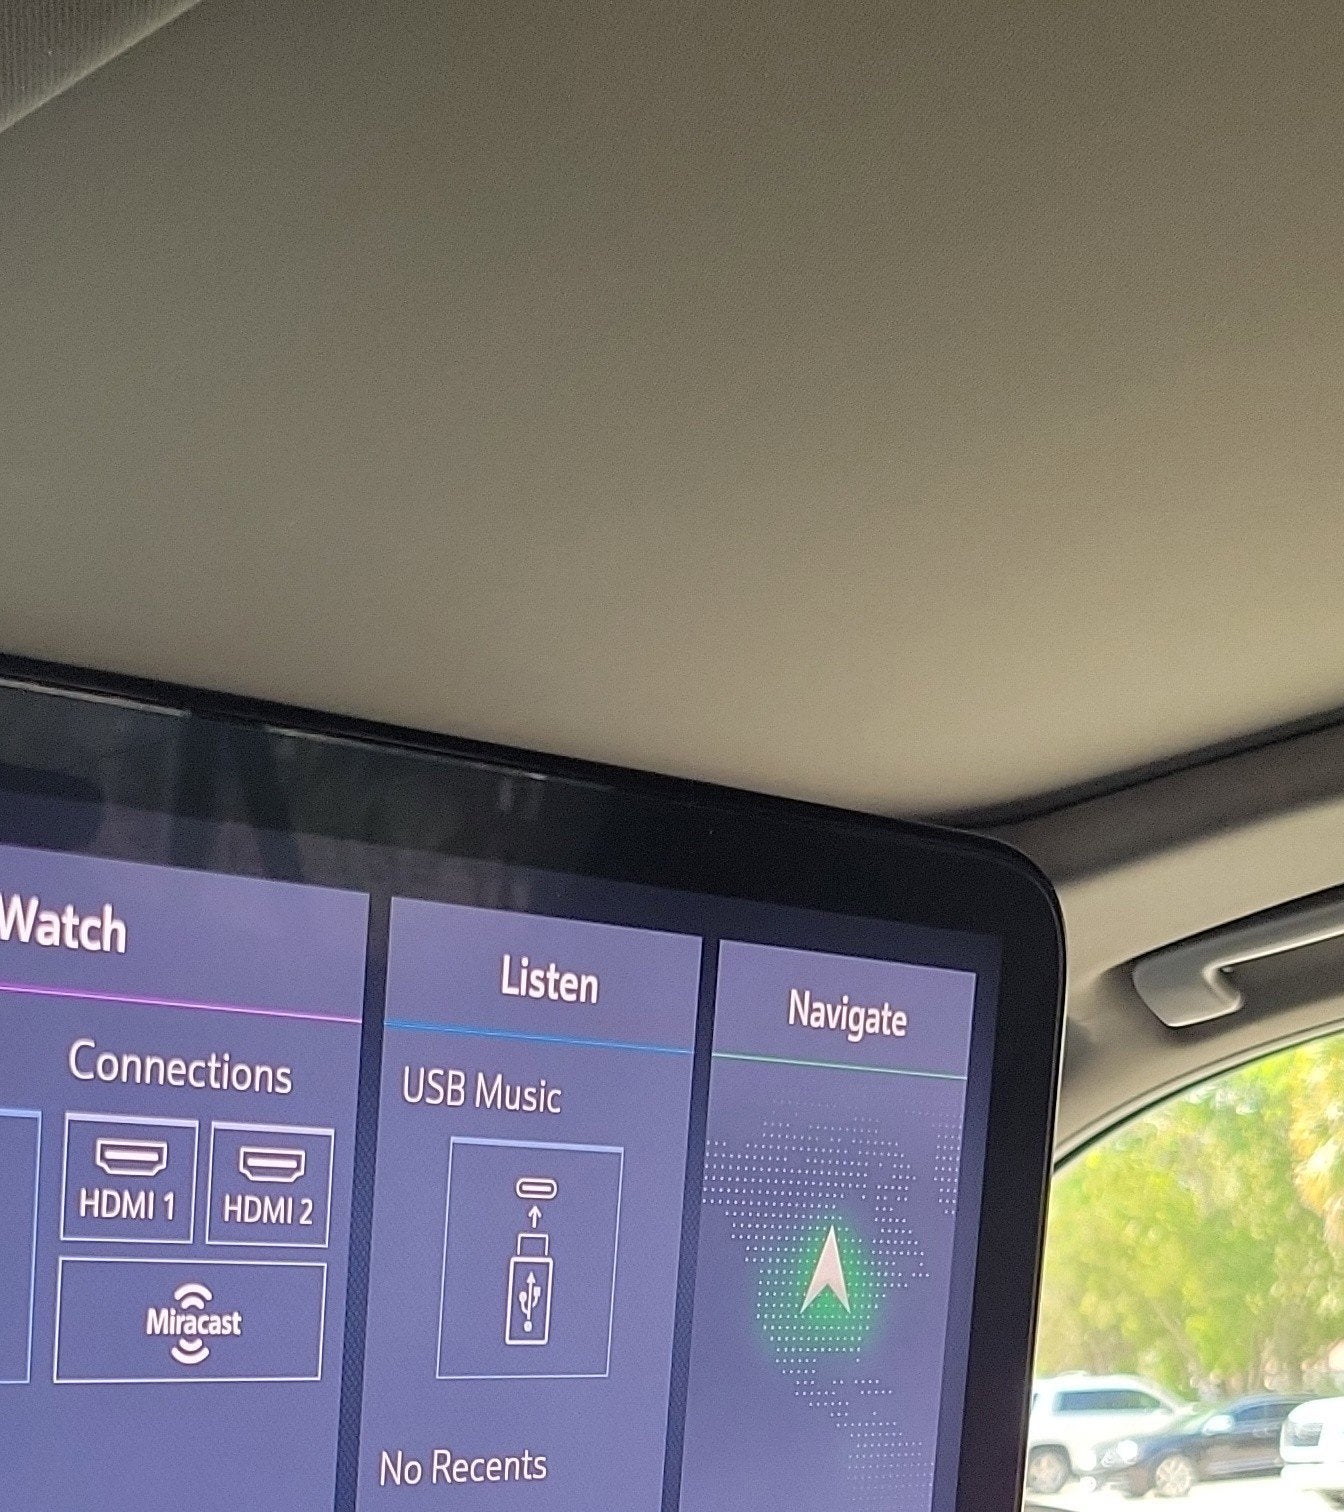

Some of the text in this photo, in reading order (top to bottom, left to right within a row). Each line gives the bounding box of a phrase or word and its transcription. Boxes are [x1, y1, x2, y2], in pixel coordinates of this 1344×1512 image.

[501, 954, 598, 1004] Listen
[788, 988, 907, 1042] Navigate
[68, 1039, 293, 1094] Connections
[403, 1065, 562, 1114] USB Music
[79, 1187, 175, 1221] HDMI 1
[223, 1194, 314, 1226] HDMI 2
[146, 1308, 242, 1336] Miracast
[379, 1449, 547, 1487] No Recents
